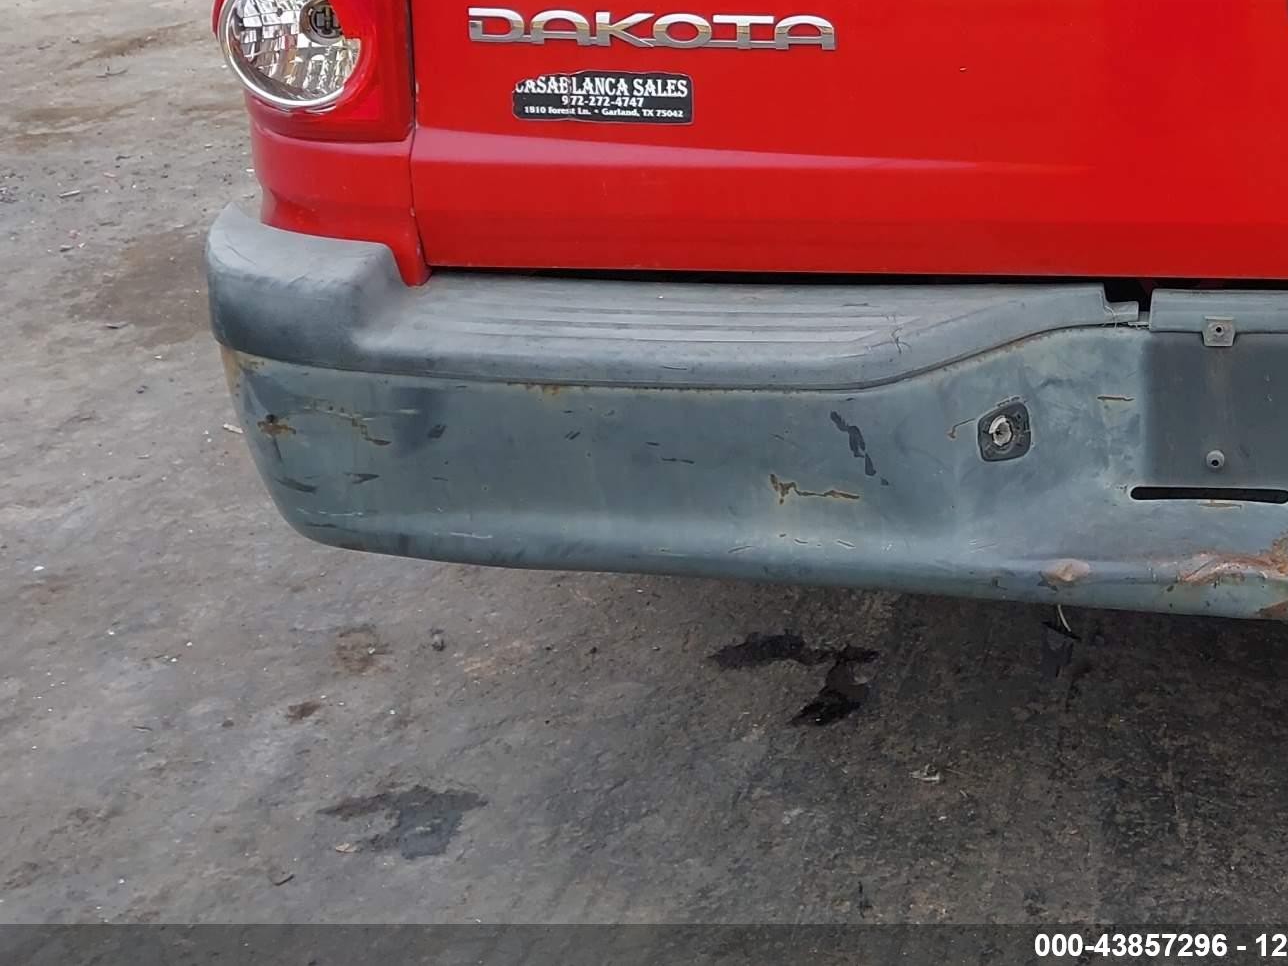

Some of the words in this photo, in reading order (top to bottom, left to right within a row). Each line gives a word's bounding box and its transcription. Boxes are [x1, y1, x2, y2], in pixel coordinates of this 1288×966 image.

[468, 7, 838, 51] DAKOTA
[632, 78, 688, 98] SALES
[561, 95, 644, 108] 972-272-4747
[642, 109, 654, 117] TX
